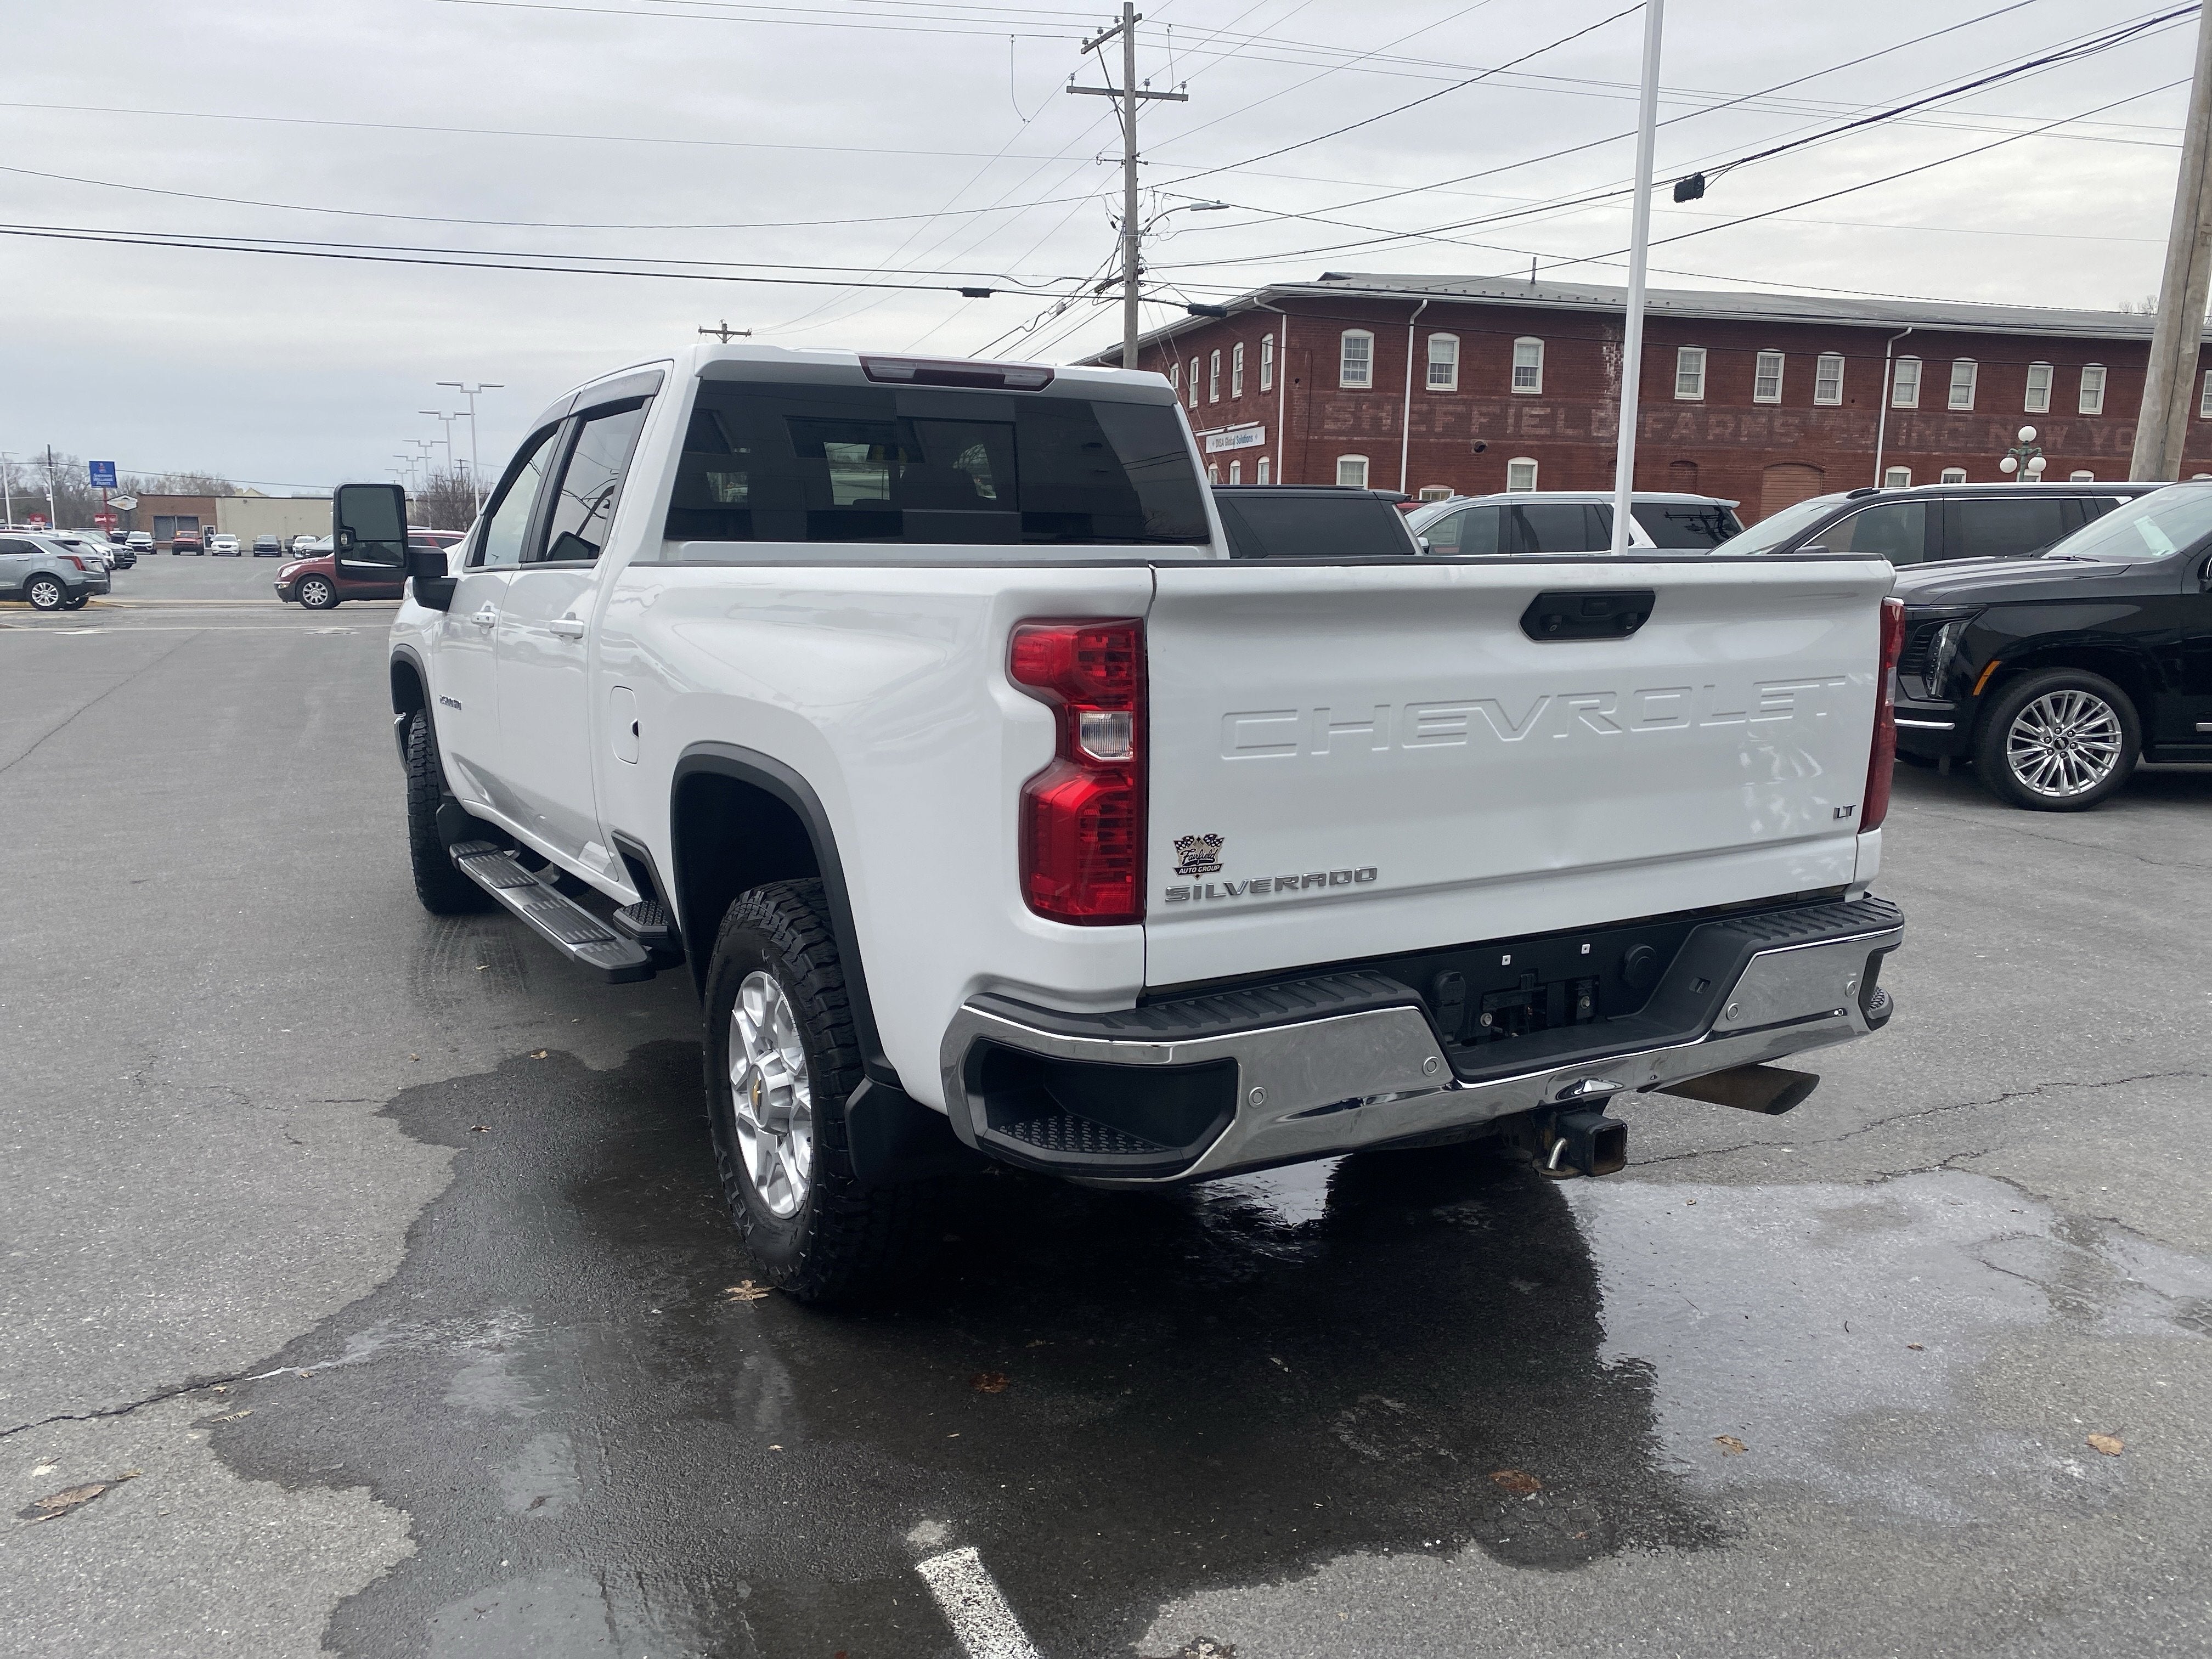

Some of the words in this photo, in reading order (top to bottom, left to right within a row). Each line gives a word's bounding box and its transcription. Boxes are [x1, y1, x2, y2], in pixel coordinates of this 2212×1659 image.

[1224, 435, 1235, 447] Global
[1237, 434, 1253, 445] Solutions
[1989, 422, 2069, 449] NW
[1221, 675, 1846, 760] CHEVROLET
[1833, 804, 1857, 819] LT
[1180, 848, 1218, 865] Fairfield
[1165, 866, 1378, 902] SILVERADO
[718, 1147, 754, 1235] KELLY
